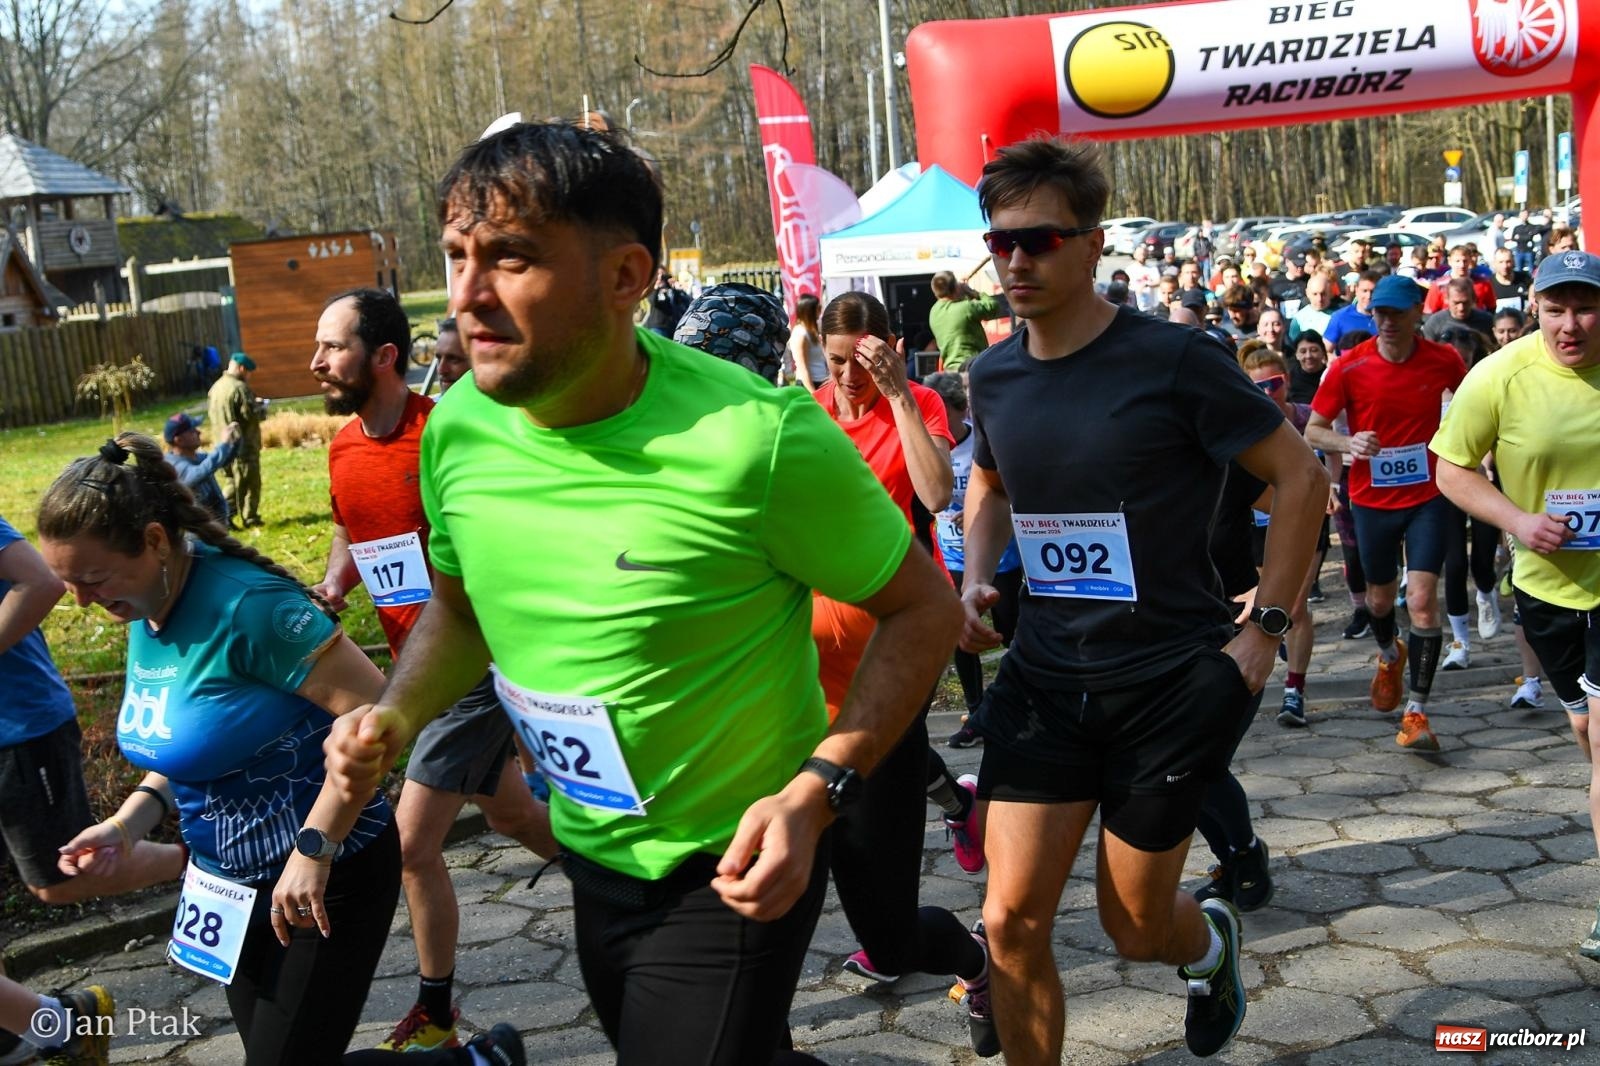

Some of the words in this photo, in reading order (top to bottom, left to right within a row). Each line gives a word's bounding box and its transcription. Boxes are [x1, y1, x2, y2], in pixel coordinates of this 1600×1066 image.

[1269, 0, 1354, 24] BIEG
[1200, 25, 1436, 71] TWARDZIELA
[1223, 66, 1413, 107] RACIBÓRZ
[1381, 458, 1418, 476] 086
[1020, 519, 1035, 528] XIV
[1038, 519, 1060, 528] BIEG
[1062, 519, 1118, 528] TWARDZIELA
[1040, 542, 1112, 574] 092
[372, 561, 404, 589] 117
[293, 611, 314, 634] SPORT
[117, 681, 172, 740] bbl
[520, 719, 602, 779] 062
[176, 896, 223, 947] 028
